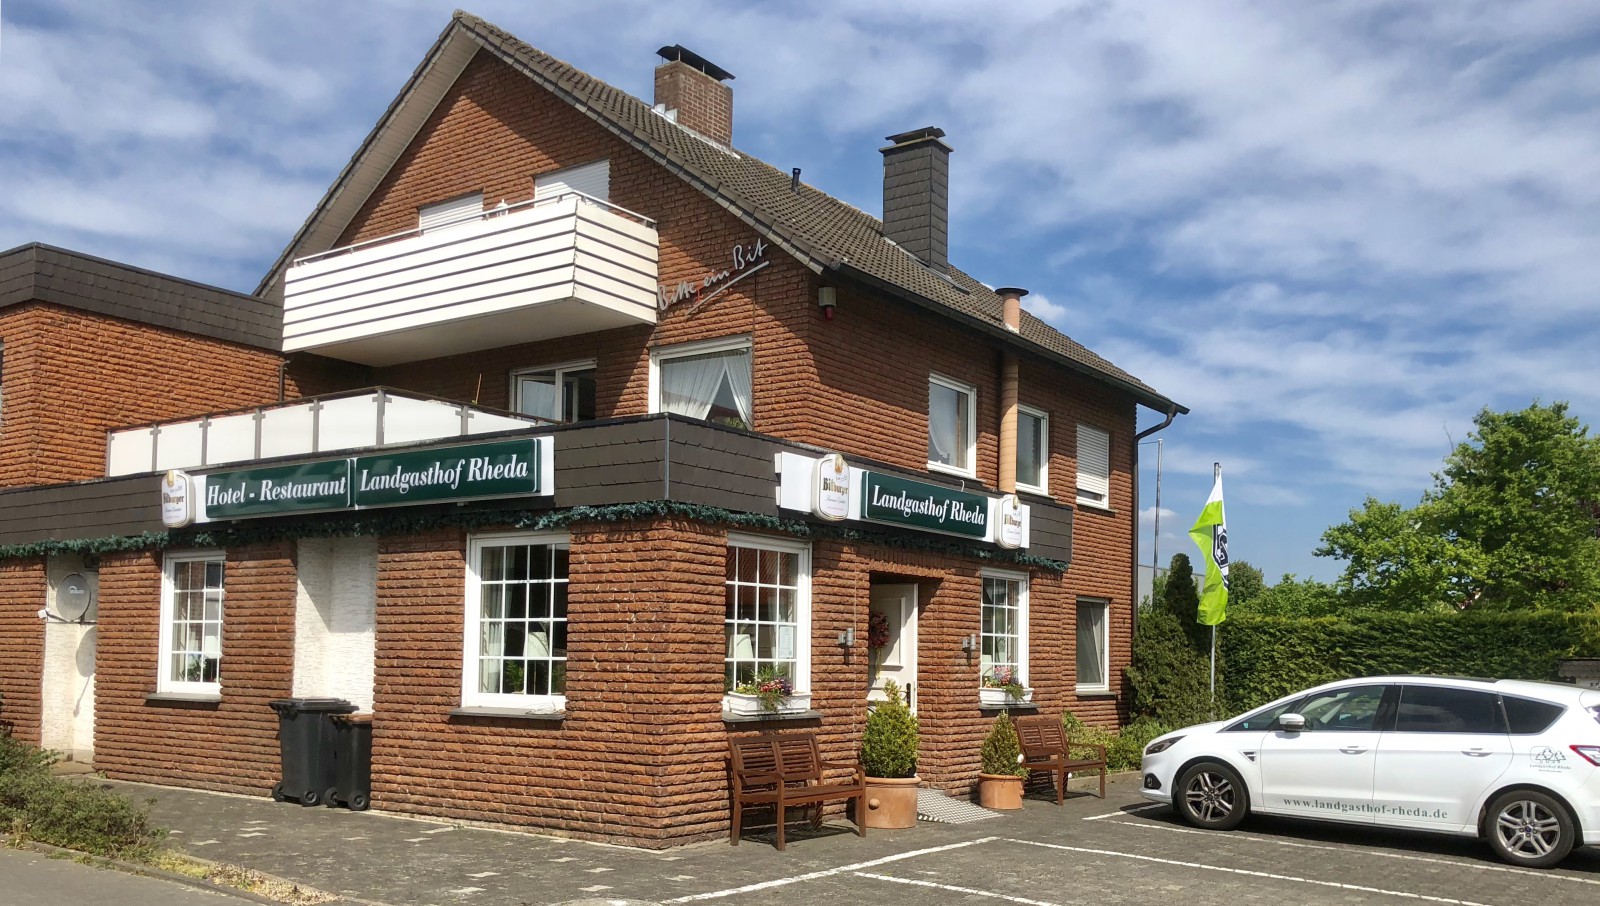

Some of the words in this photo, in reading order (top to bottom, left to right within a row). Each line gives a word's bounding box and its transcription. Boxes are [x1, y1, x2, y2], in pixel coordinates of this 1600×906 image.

[703, 268, 730, 287] ein
[733, 238, 768, 269] Bit
[206, 482, 246, 506] Hotel
[259, 476, 346, 501] Restaurant
[359, 459, 465, 494] Landgasthof
[467, 454, 529, 482] Rheda
[872, 485, 950, 523] Landgasthof
[949, 500, 985, 526] Rheda
[1283, 797, 1448, 819] www.landgasthof-rheda.de
